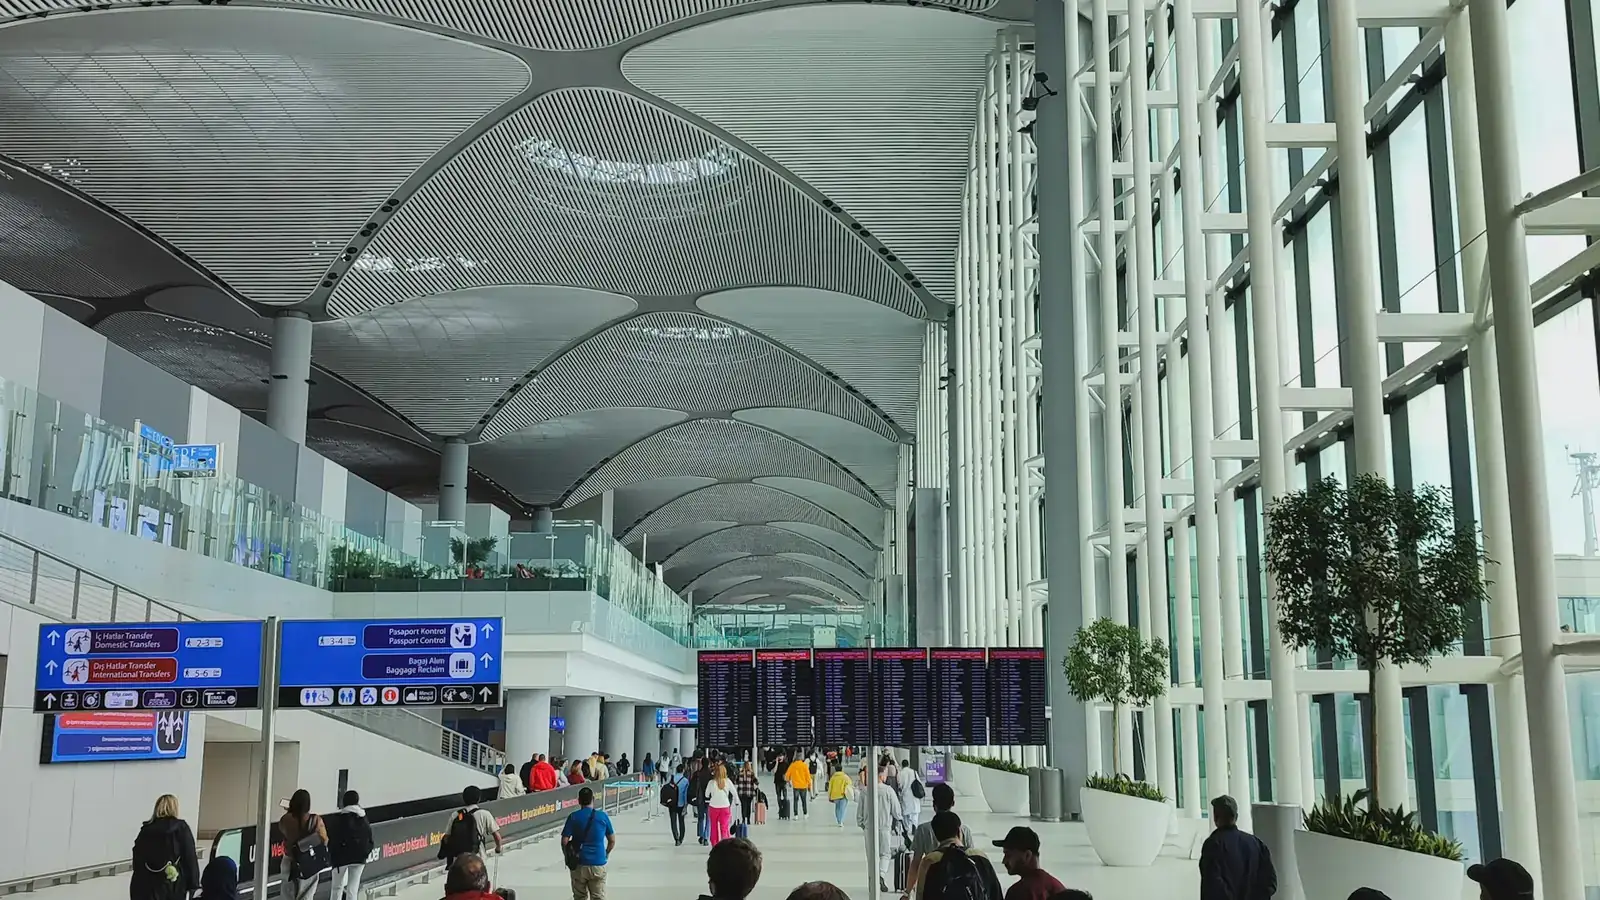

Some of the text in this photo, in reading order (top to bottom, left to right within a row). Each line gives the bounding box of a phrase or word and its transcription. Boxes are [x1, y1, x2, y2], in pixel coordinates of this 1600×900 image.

[191, 448, 197, 456] F
[103, 632, 124, 640] Hatlar
[125, 631, 153, 640] Transfer
[389, 627, 446, 637] Pasaport Kontrol
[95, 640, 161, 649] Domestic Transfers
[197, 639, 210, 647] 2-3
[330, 637, 343, 645] 3-4
[389, 636, 446, 646] Passport Control
[106, 662, 128, 670] Hatlar
[128, 661, 156, 669] Transfer
[408, 657, 428, 666] Bagaj
[93, 669, 171, 678] International Transfers
[195, 669, 209, 678] 5-6
[386, 665, 445, 676] Baggage Reclaim
[382, 841, 405, 858] Welcome
